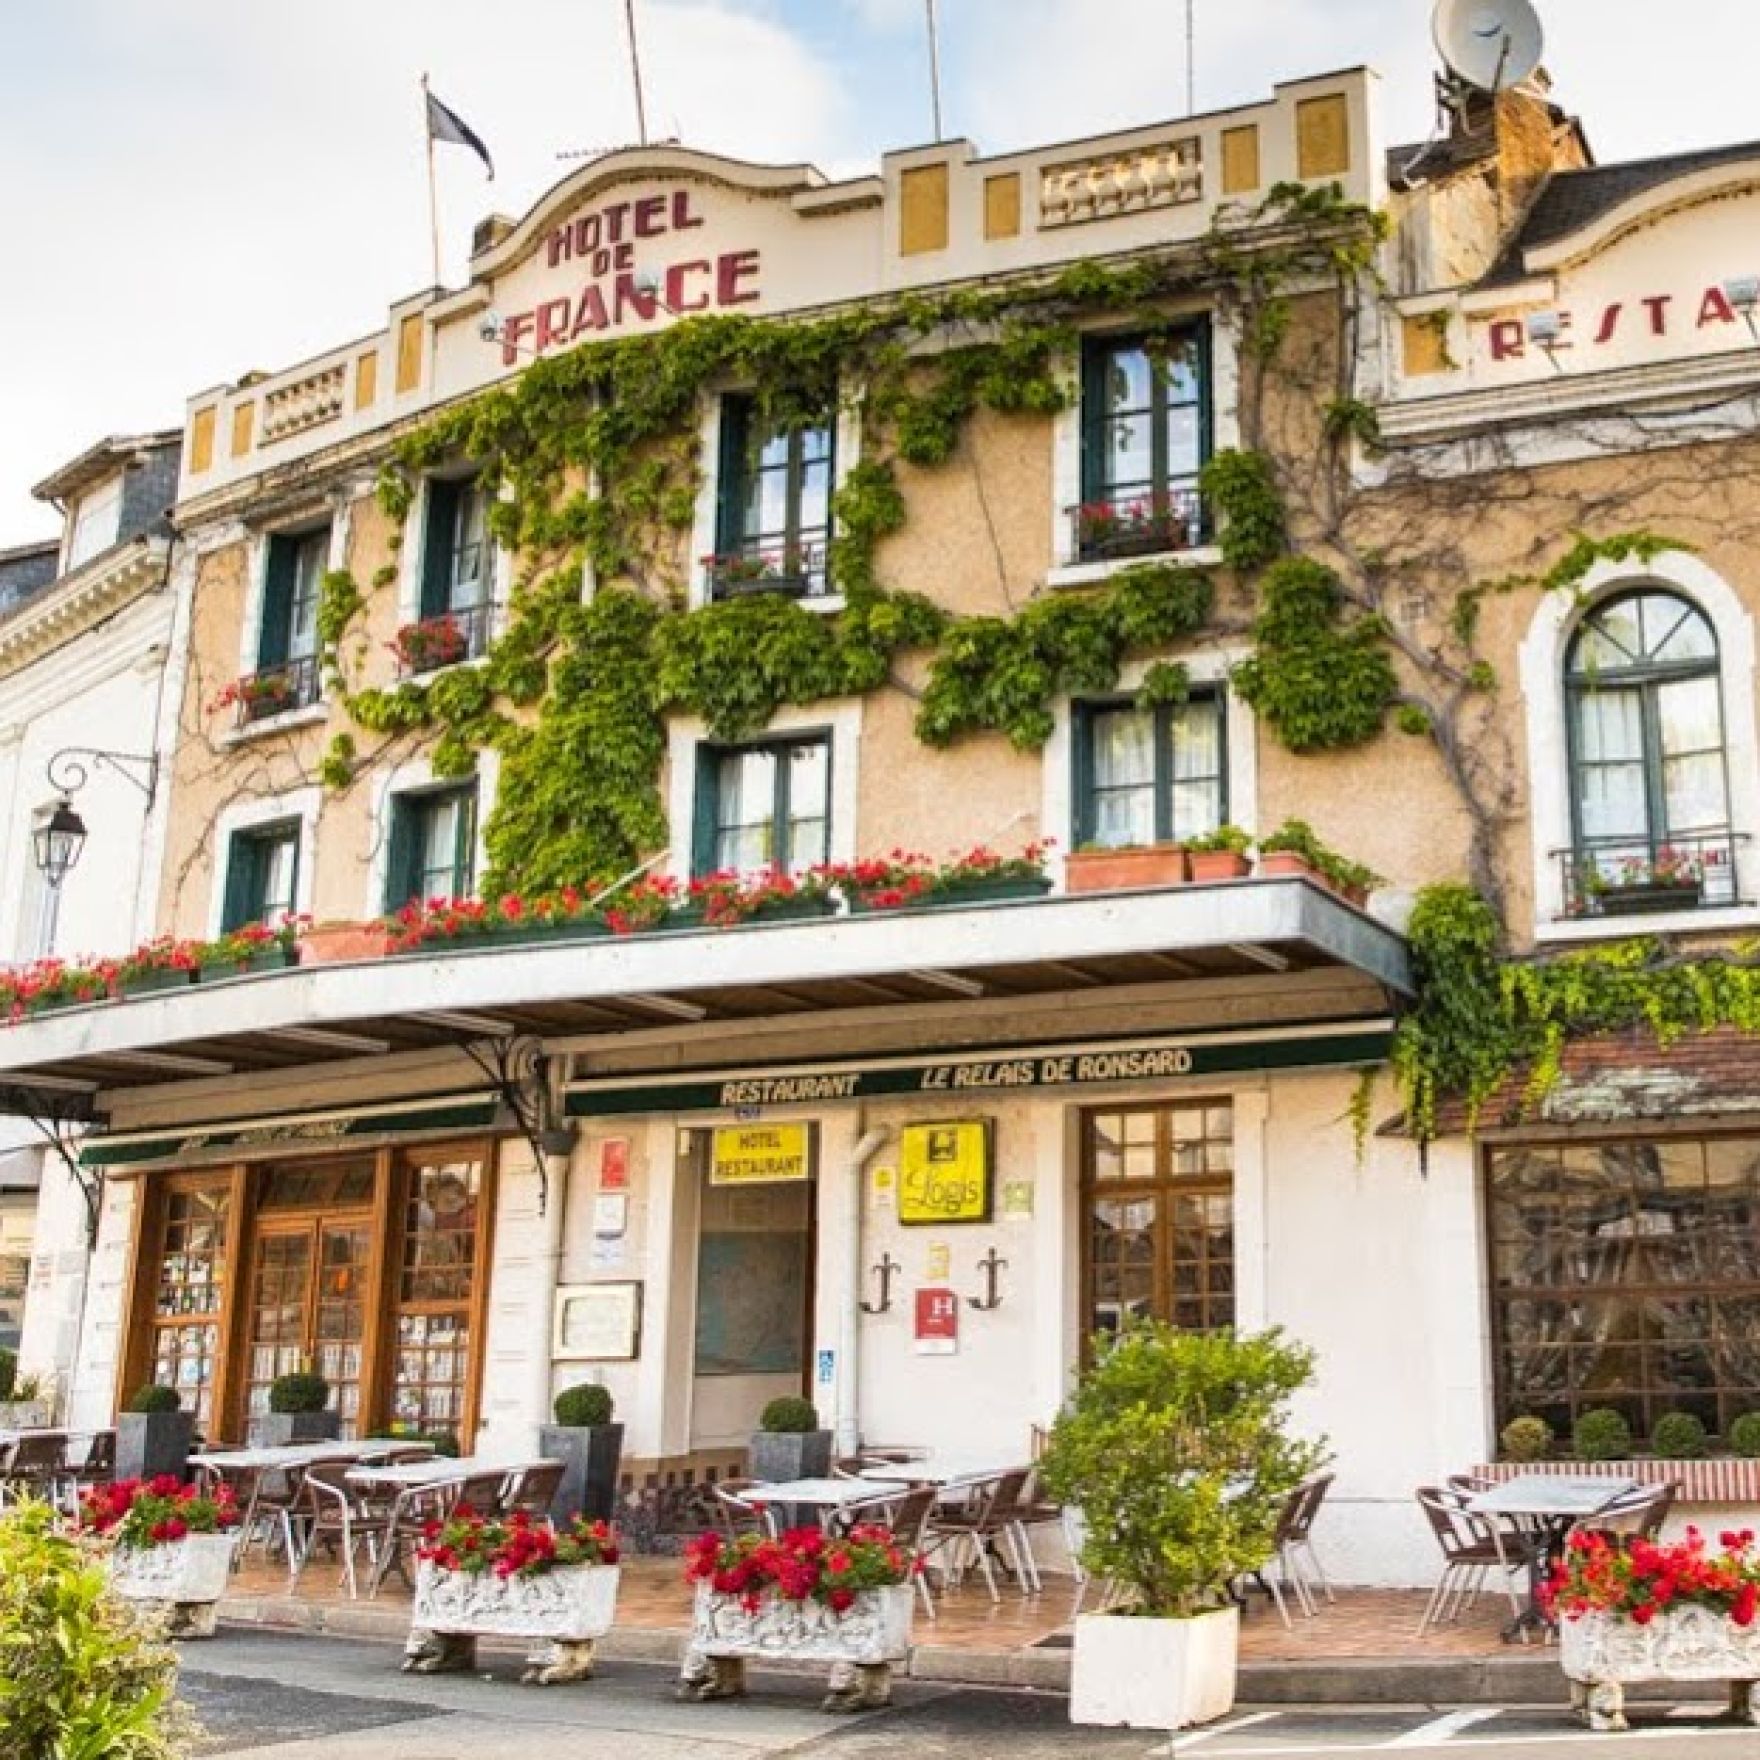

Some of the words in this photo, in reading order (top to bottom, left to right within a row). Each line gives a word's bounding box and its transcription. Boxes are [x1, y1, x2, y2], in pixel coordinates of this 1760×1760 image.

[547, 190, 704, 268] HOTEL
[592, 242, 634, 277] DE
[502, 249, 760, 367] FRANCE
[920, 1067, 949, 1089] LE
[953, 1061, 1035, 1088] RELAIS
[1039, 1057, 1074, 1083] DE
[1078, 1049, 1193, 1081] RONSARD
[722, 1073, 861, 1106] RESTAURANT
[739, 1131, 781, 1149] HOTEL
[716, 1155, 803, 1176] RESTAURANT
[933, 1296, 953, 1316] H
